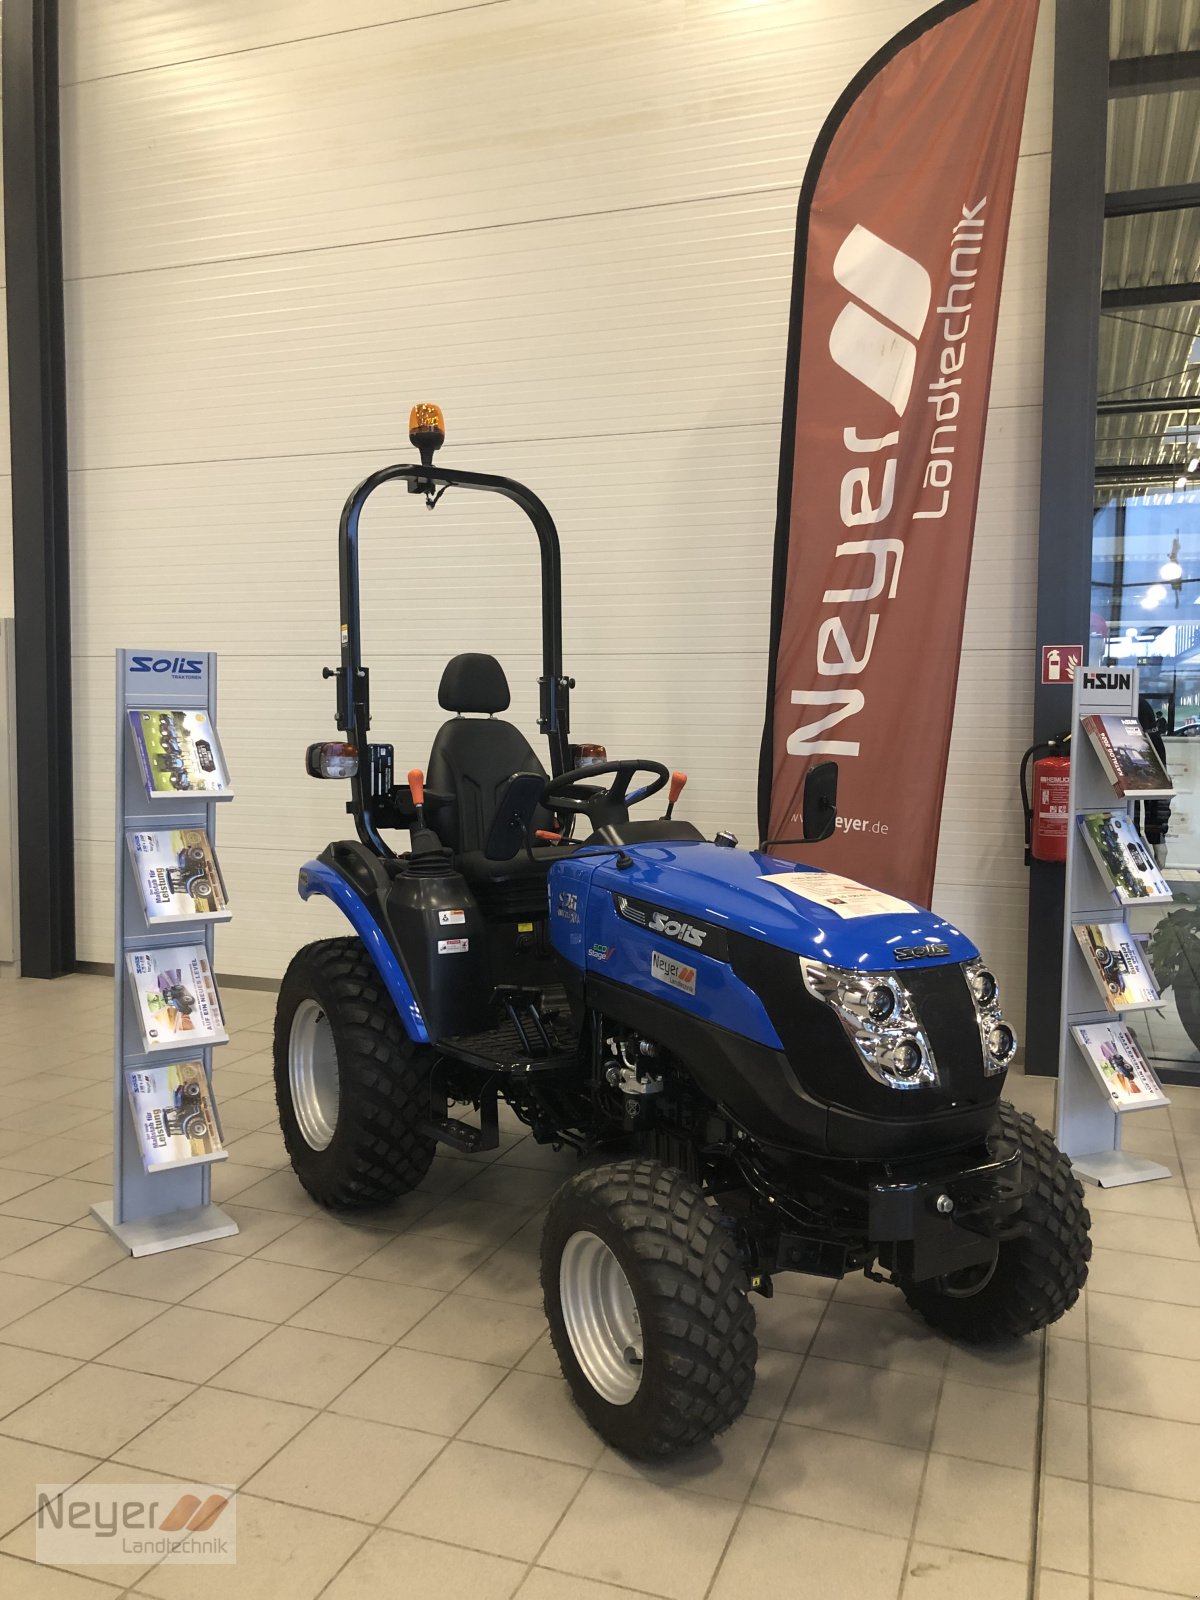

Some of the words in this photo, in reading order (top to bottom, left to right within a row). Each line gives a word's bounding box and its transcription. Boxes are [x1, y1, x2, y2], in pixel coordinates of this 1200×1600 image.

[912, 196, 987, 520] Landtechnik
[786, 426, 905, 757] Neyer
[156, 867, 171, 903] Leistung
[191, 958, 201, 979] LEVEL
[653, 953, 679, 977] Neyer
[153, 1108, 167, 1148] Leistung
